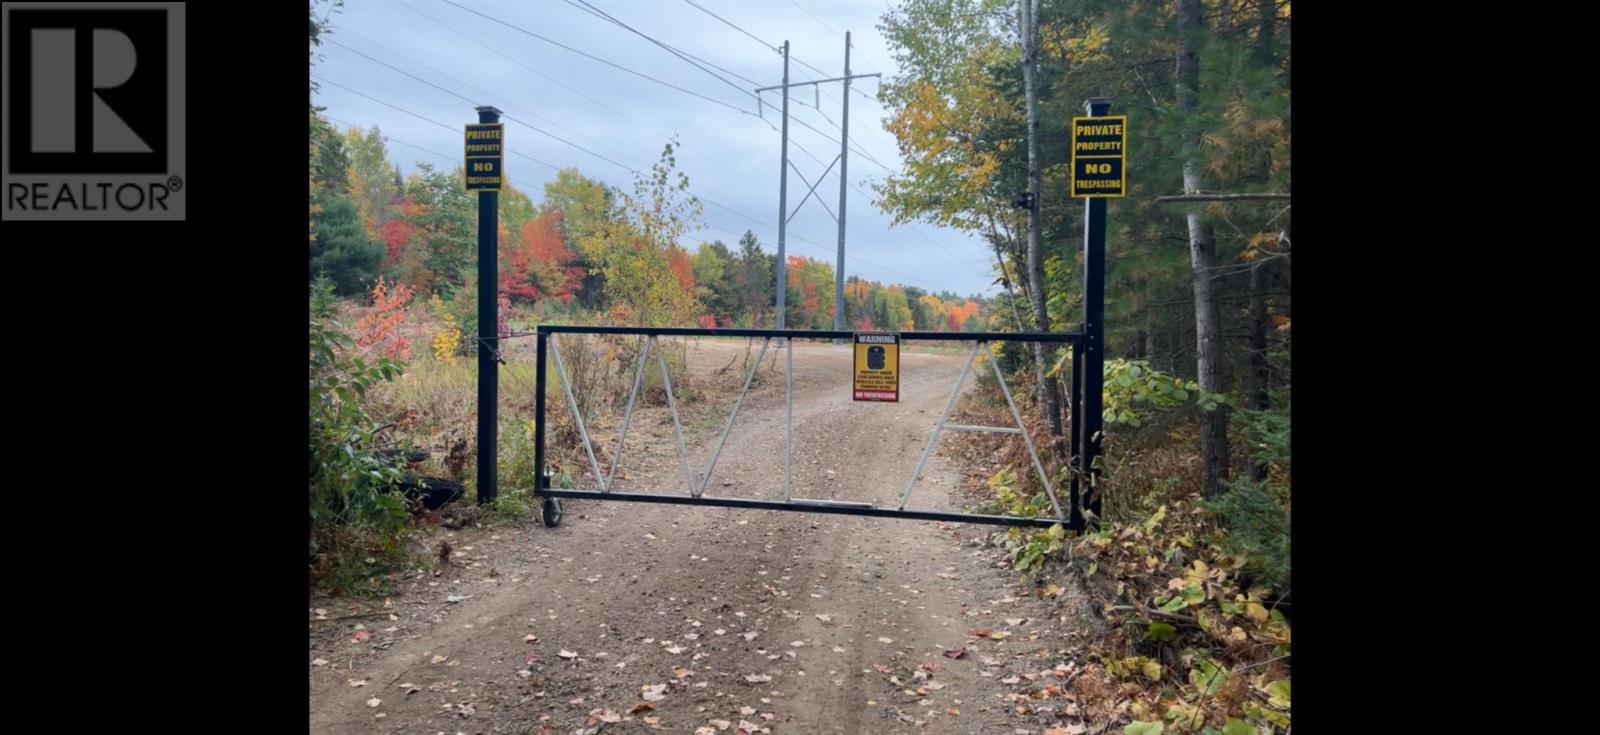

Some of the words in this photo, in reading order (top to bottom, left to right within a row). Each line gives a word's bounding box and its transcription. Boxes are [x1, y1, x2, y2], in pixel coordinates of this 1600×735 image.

[467, 130, 501, 140] PRIVATE
[1076, 124, 1123, 136] PRIVATE
[465, 144, 500, 152] PROPERTY
[1076, 141, 1122, 151] PROPERTY
[473, 162, 494, 172] NO
[1085, 163, 1112, 175] NO
[1076, 179, 1122, 189] TRESPASSING
[858, 335, 896, 344] WARNING
